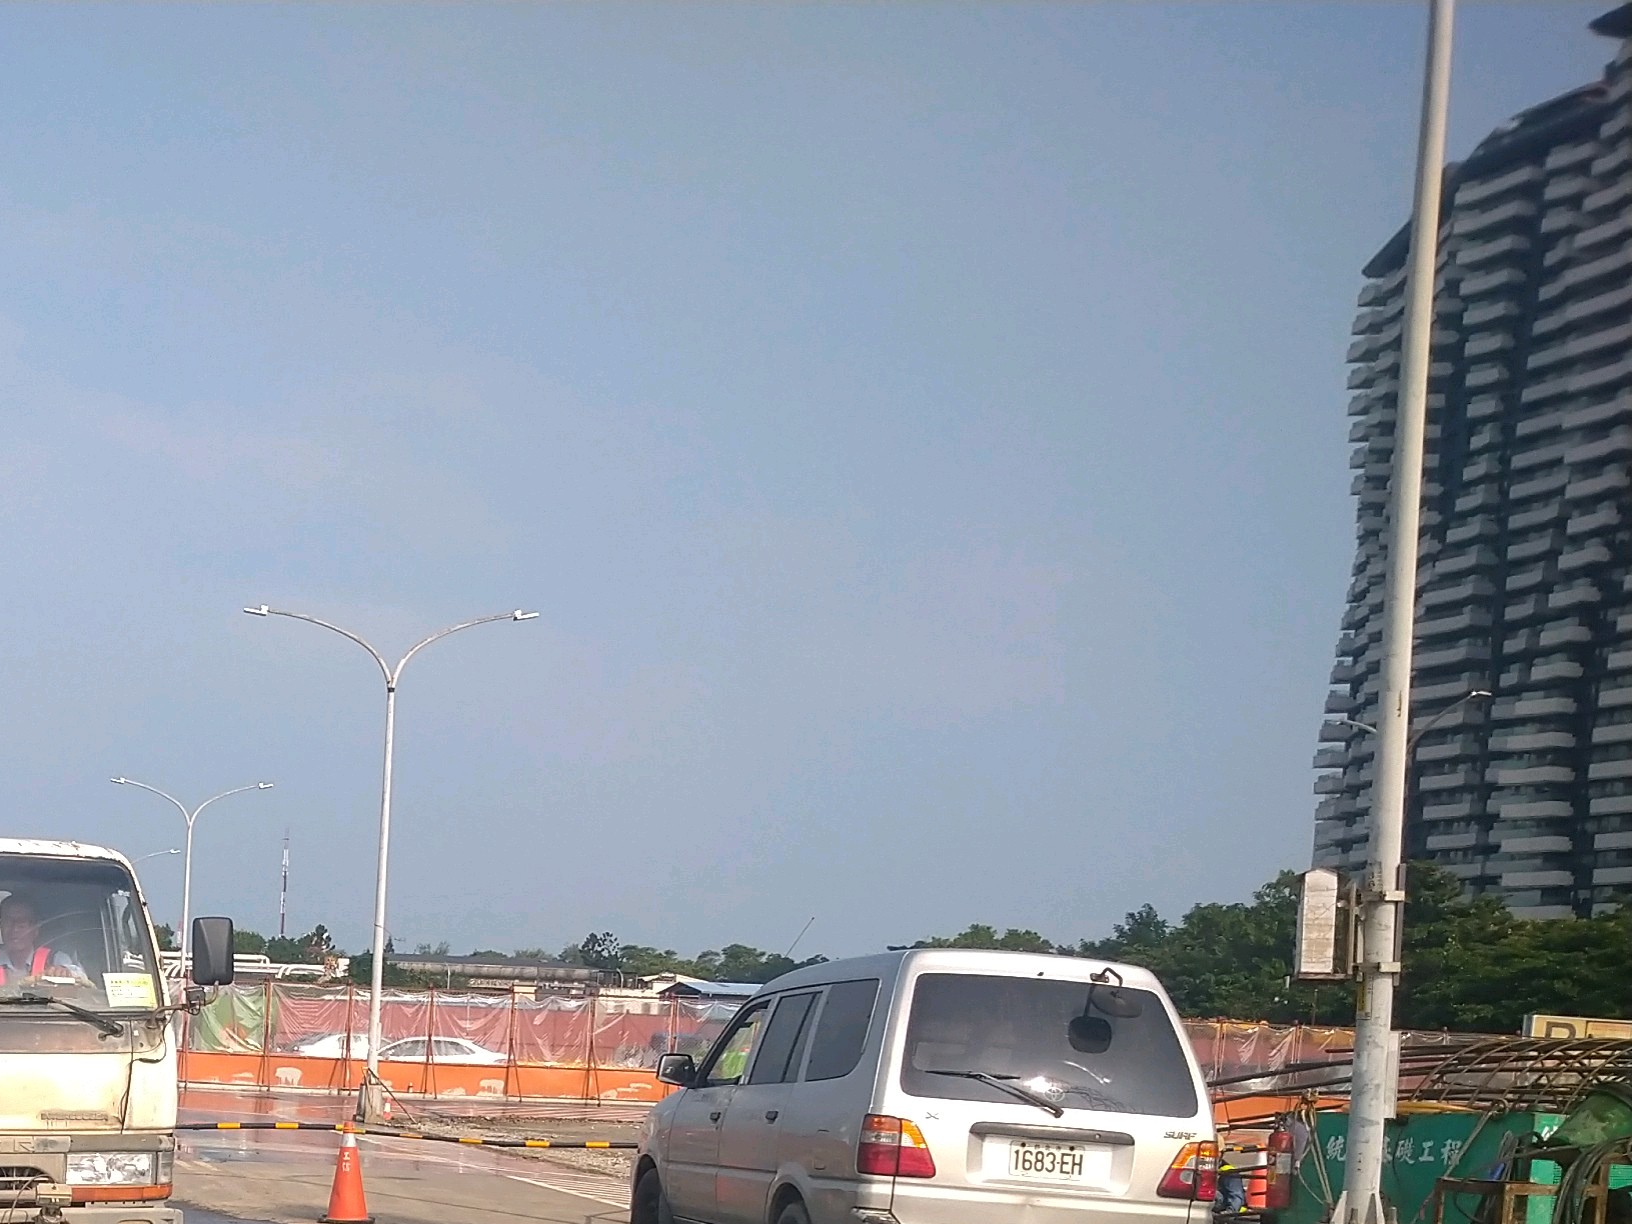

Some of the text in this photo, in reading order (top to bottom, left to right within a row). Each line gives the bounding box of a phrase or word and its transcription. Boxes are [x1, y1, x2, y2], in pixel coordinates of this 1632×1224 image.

[1163, 1131, 1198, 1140] SURF
[1014, 1149, 1084, 1176] 1683-EH
[1326, 1136, 1462, 1166] 統礎工程
